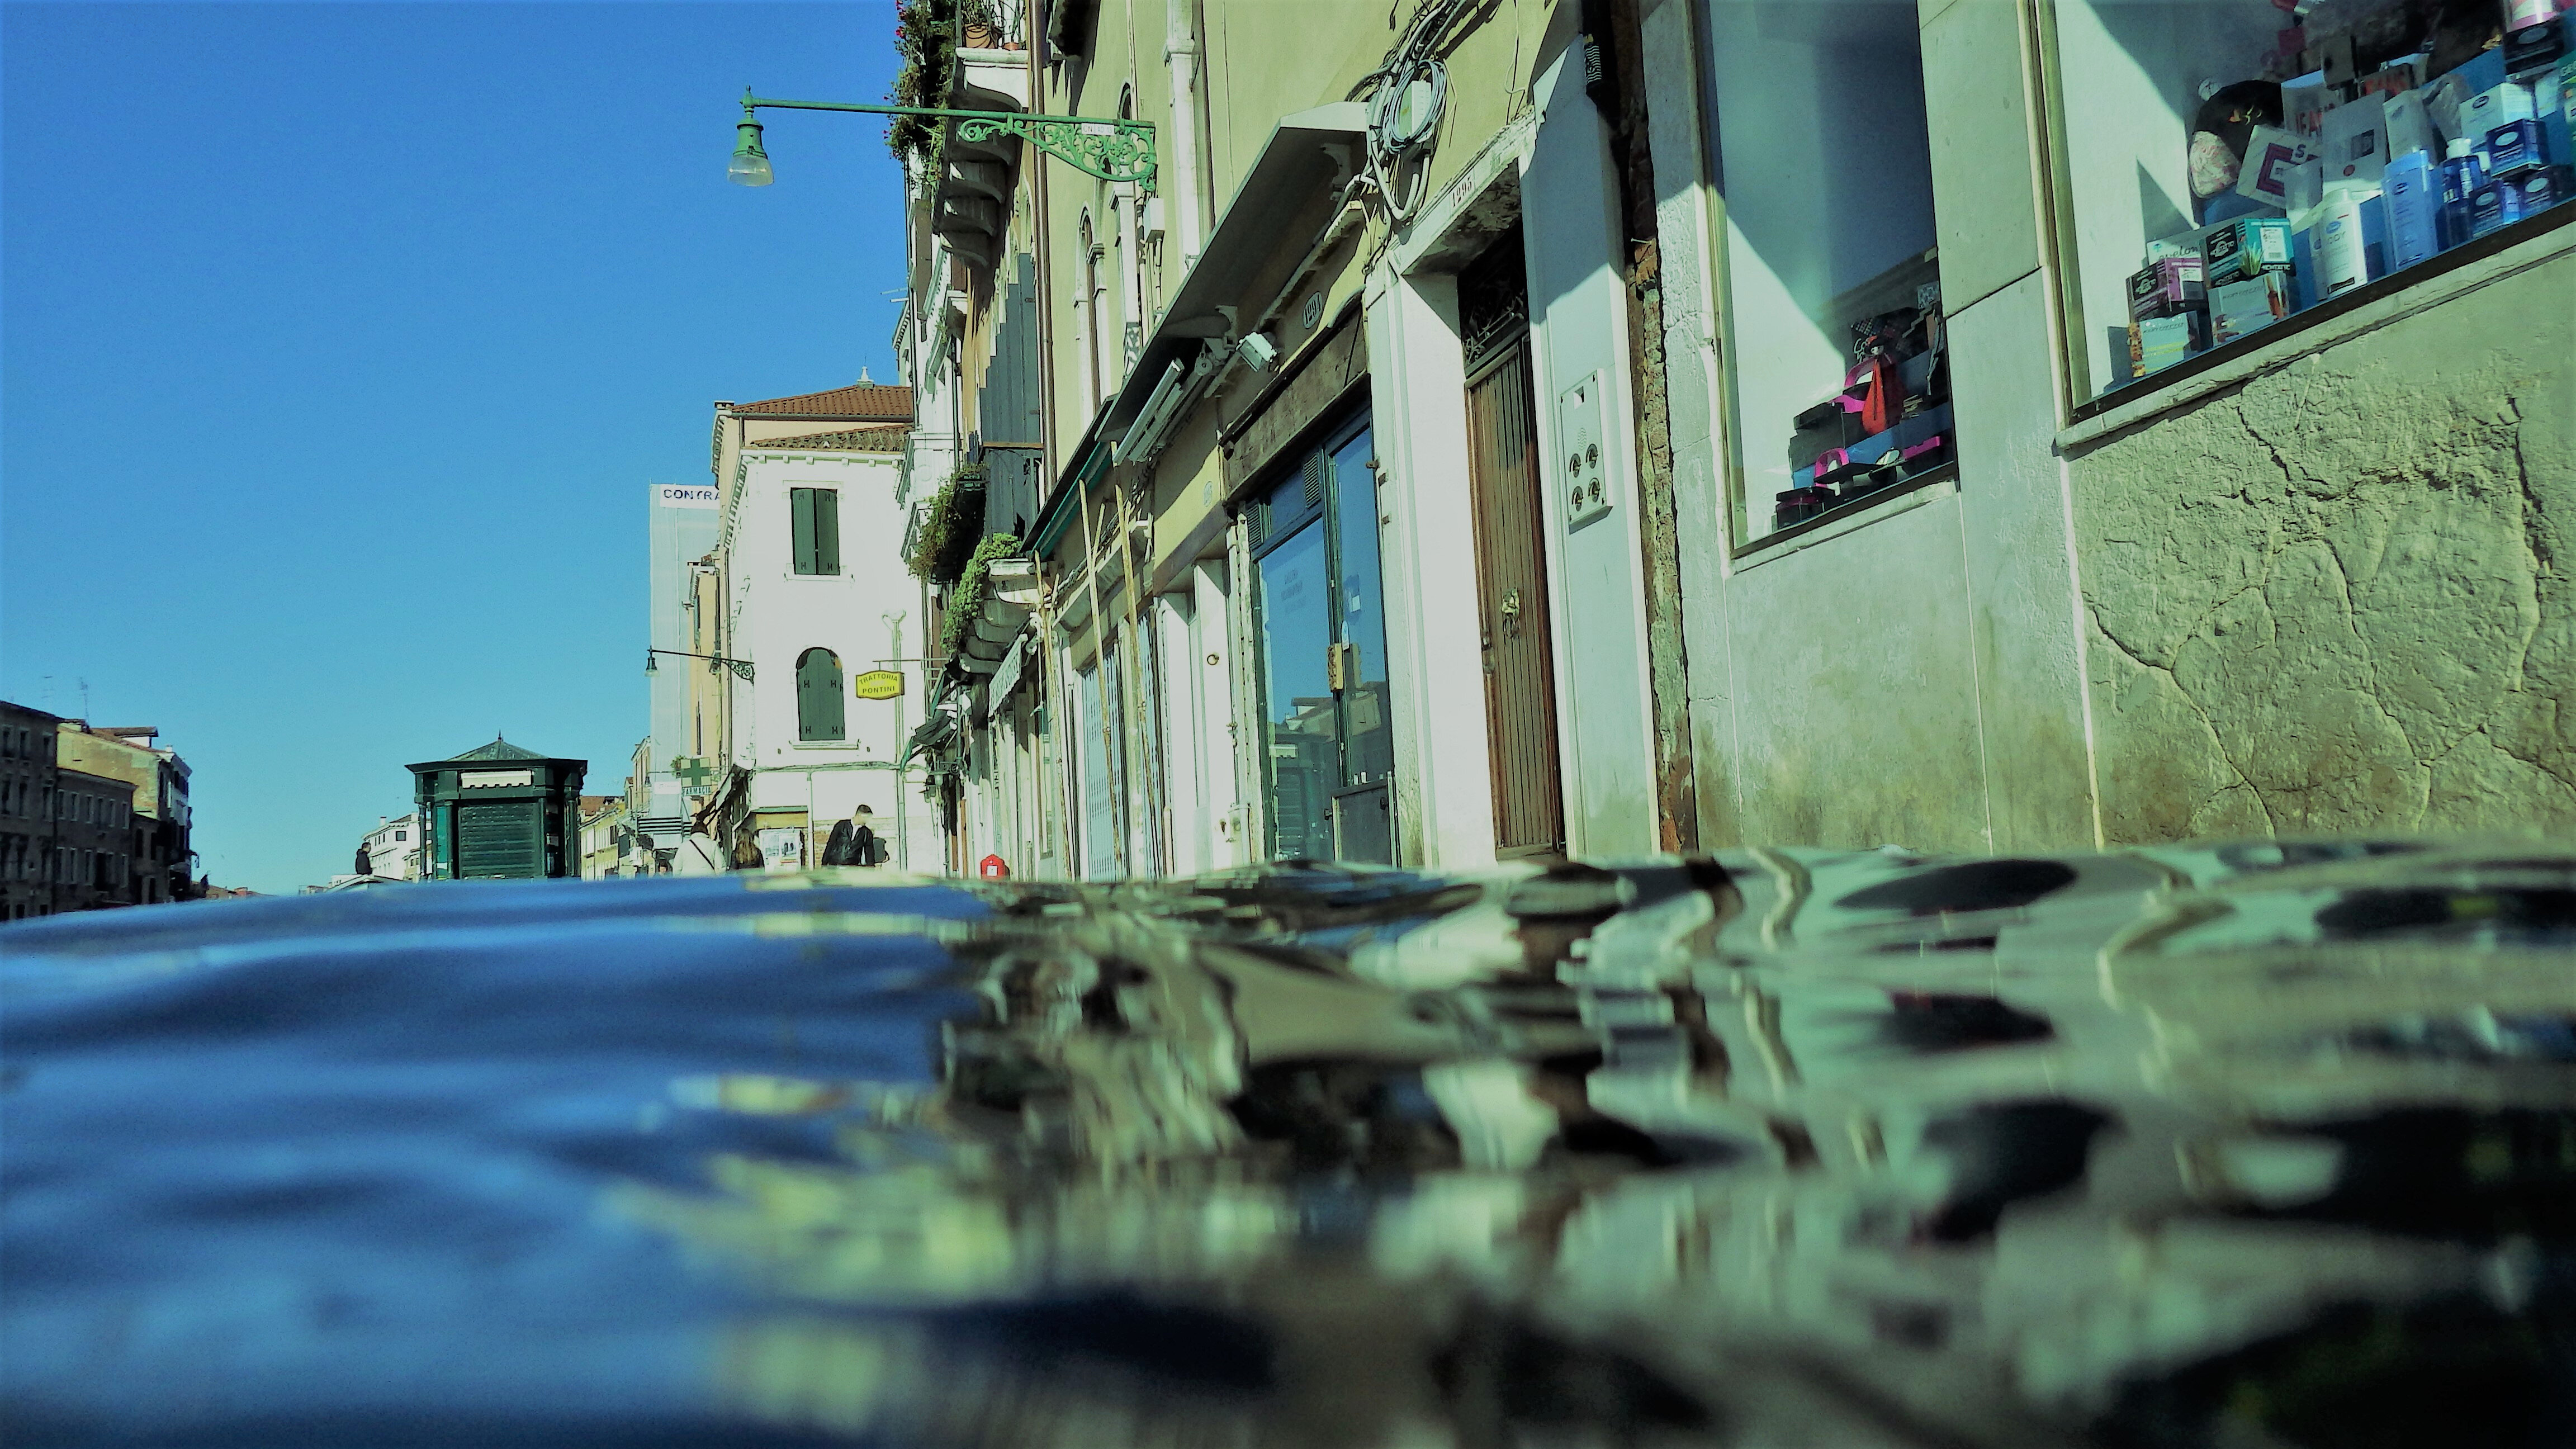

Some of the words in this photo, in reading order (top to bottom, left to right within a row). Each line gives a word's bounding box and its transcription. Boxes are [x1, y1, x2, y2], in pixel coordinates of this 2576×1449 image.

[1453, 175, 1472, 207] 1295
[1305, 294, 1321, 325] 1294
[859, 673, 897, 684] TRATTORIA
[862, 685, 895, 694] PONTINI
[683, 787, 711, 795] FARMACIA
